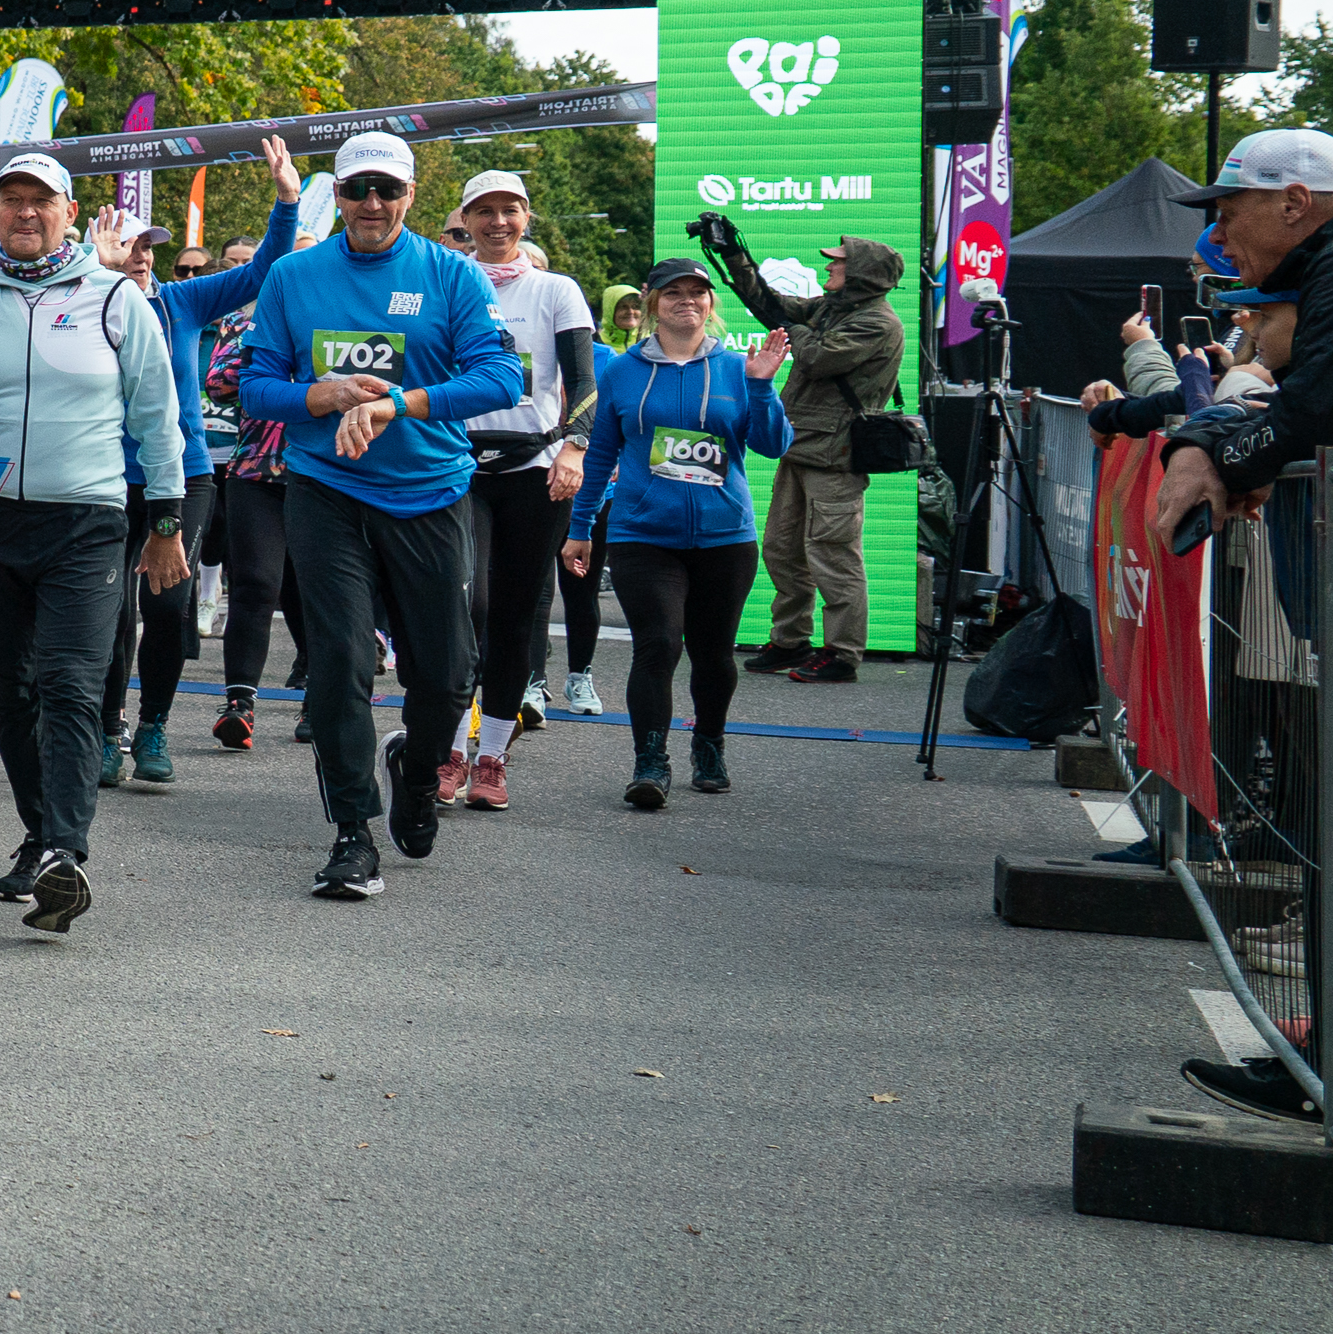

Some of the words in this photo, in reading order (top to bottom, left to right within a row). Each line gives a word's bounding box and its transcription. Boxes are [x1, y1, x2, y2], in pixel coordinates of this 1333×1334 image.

[355, 149, 394, 159] ESTONIA
[738, 176, 812, 201] Tartu
[820, 175, 872, 200] Mill
[390, 291, 424, 301] TERVE
[389, 299, 422, 308] EESTI
[323, 341, 393, 369] 1702
[481, 449, 501, 458] NIKE
[663, 436, 722, 465] 1601
